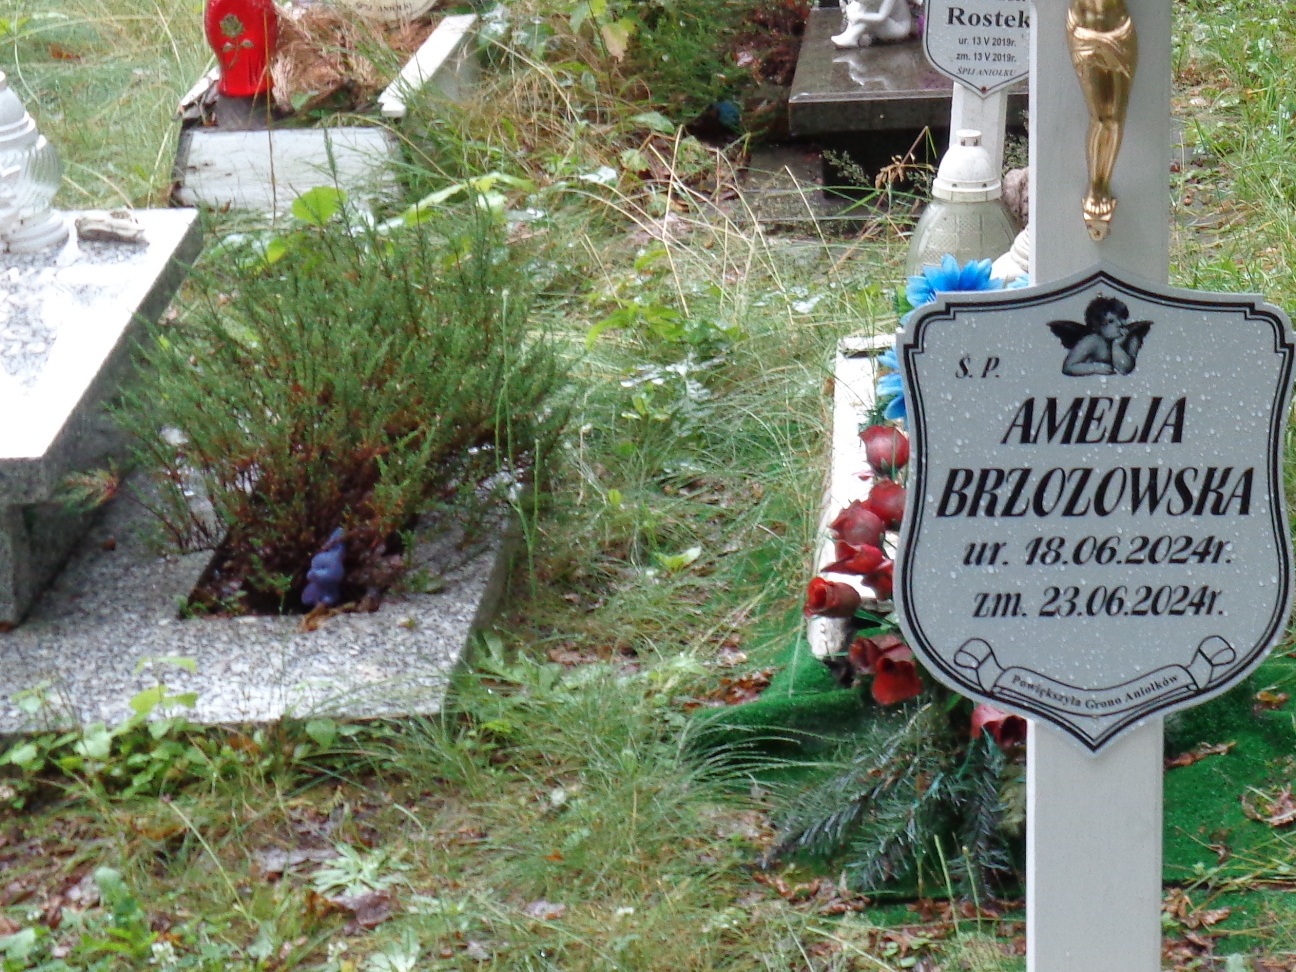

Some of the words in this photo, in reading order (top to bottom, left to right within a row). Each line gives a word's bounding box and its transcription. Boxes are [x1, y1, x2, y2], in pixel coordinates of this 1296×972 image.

[947, 6, 1030, 29] Rostek
[972, 36, 982, 46] 13
[984, 36, 992, 46] V
[992, 36, 1017, 48] 2019r.
[973, 51, 983, 61] 13
[984, 51, 992, 61] V
[992, 52, 1017, 63] 2019r.
[1000, 395, 1187, 445] AMELIA
[935, 466, 1255, 518] BRZOZOWSKA
[962, 540, 1009, 567] ur.
[1025, 534, 1233, 567] 18.06.2024r.
[972, 590, 1028, 618] zm.
[1038, 584, 1225, 618] 23.06.2024r.
[1085, 696, 1123, 711] Grono
